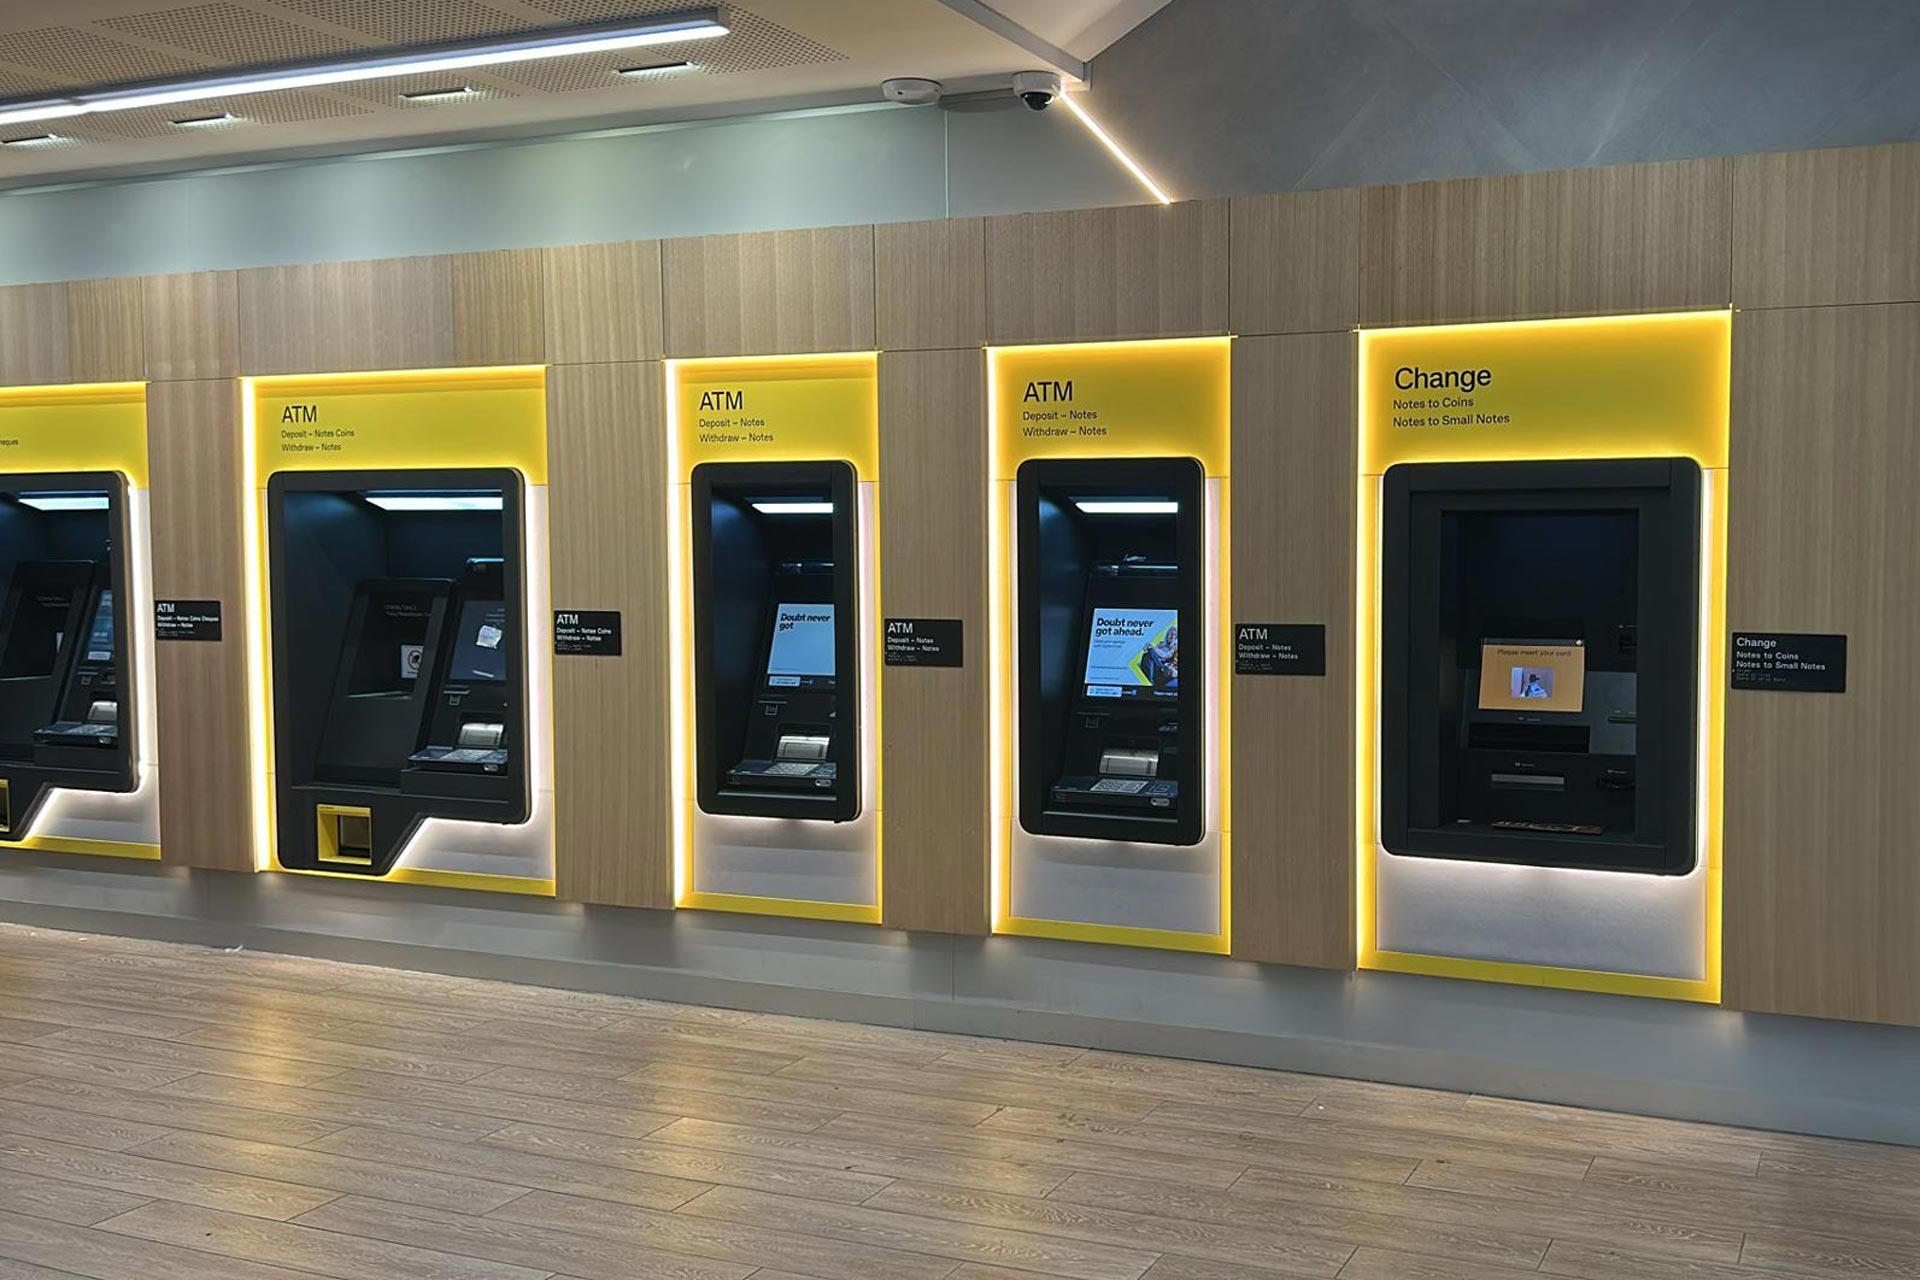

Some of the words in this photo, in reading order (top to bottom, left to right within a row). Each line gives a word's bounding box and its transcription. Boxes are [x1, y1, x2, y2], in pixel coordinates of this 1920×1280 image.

[1395, 366, 1492, 393] Change
[1023, 380, 1073, 402] ATM
[699, 390, 743, 411] ATM
[1393, 398, 1425, 410] Notes
[1428, 399, 1440, 408] to
[1442, 397, 1474, 408] Coins
[281, 404, 318, 423] ATM
[1022, 411, 1058, 423] Deposit
[1069, 410, 1098, 420] Notes
[698, 418, 730, 430] Deposit
[740, 417, 765, 427] Notes
[1393, 416, 1425, 428] Notes
[1428, 417, 1440, 426] to
[1442, 415, 1474, 426] Small
[1476, 413, 1511, 425] Notes
[281, 429, 307, 440] Deposit
[314, 428, 334, 438] Notes
[335, 428, 355, 438] Coins
[1022, 426, 1069, 437] Withdraw
[1078, 425, 1108, 436] Notes
[698, 432, 740, 443] Withdraw
[748, 432, 774, 442] Notes
[281, 443, 315, 452] Withdraw
[321, 442, 342, 452] Notes
[157, 602, 176, 613] ATM
[556, 613, 579, 625] ATM
[780, 613, 806, 622] Doubt
[806, 615, 831, 623] never
[1096, 617, 1126, 627] Doubt
[1126, 619, 1155, 628] never
[779, 621, 795, 632] got
[887, 621, 914, 634] ATM
[1095, 628, 1114, 637] got
[1113, 627, 1145, 636] ahead.
[1239, 627, 1268, 640] ATM
[887, 636, 910, 644] Deposit
[916, 636, 934, 644] Notes
[1736, 636, 1777, 650] Change
[922, 644, 940, 652] Notes
[1238, 643, 1264, 652] Deposit
[1272, 643, 1292, 652] Notes
[1238, 652, 1271, 660] Withdraw
[1278, 652, 1299, 660] Notes
[1736, 651, 1761, 659] Notes
[1763, 652, 1773, 660] to
[1775, 651, 1799, 660] Coins
[1736, 660, 1761, 669] Notes
[1763, 661, 1773, 669] to
[1775, 661, 1799, 671] Small
[1801, 662, 1826, 671] Notes
